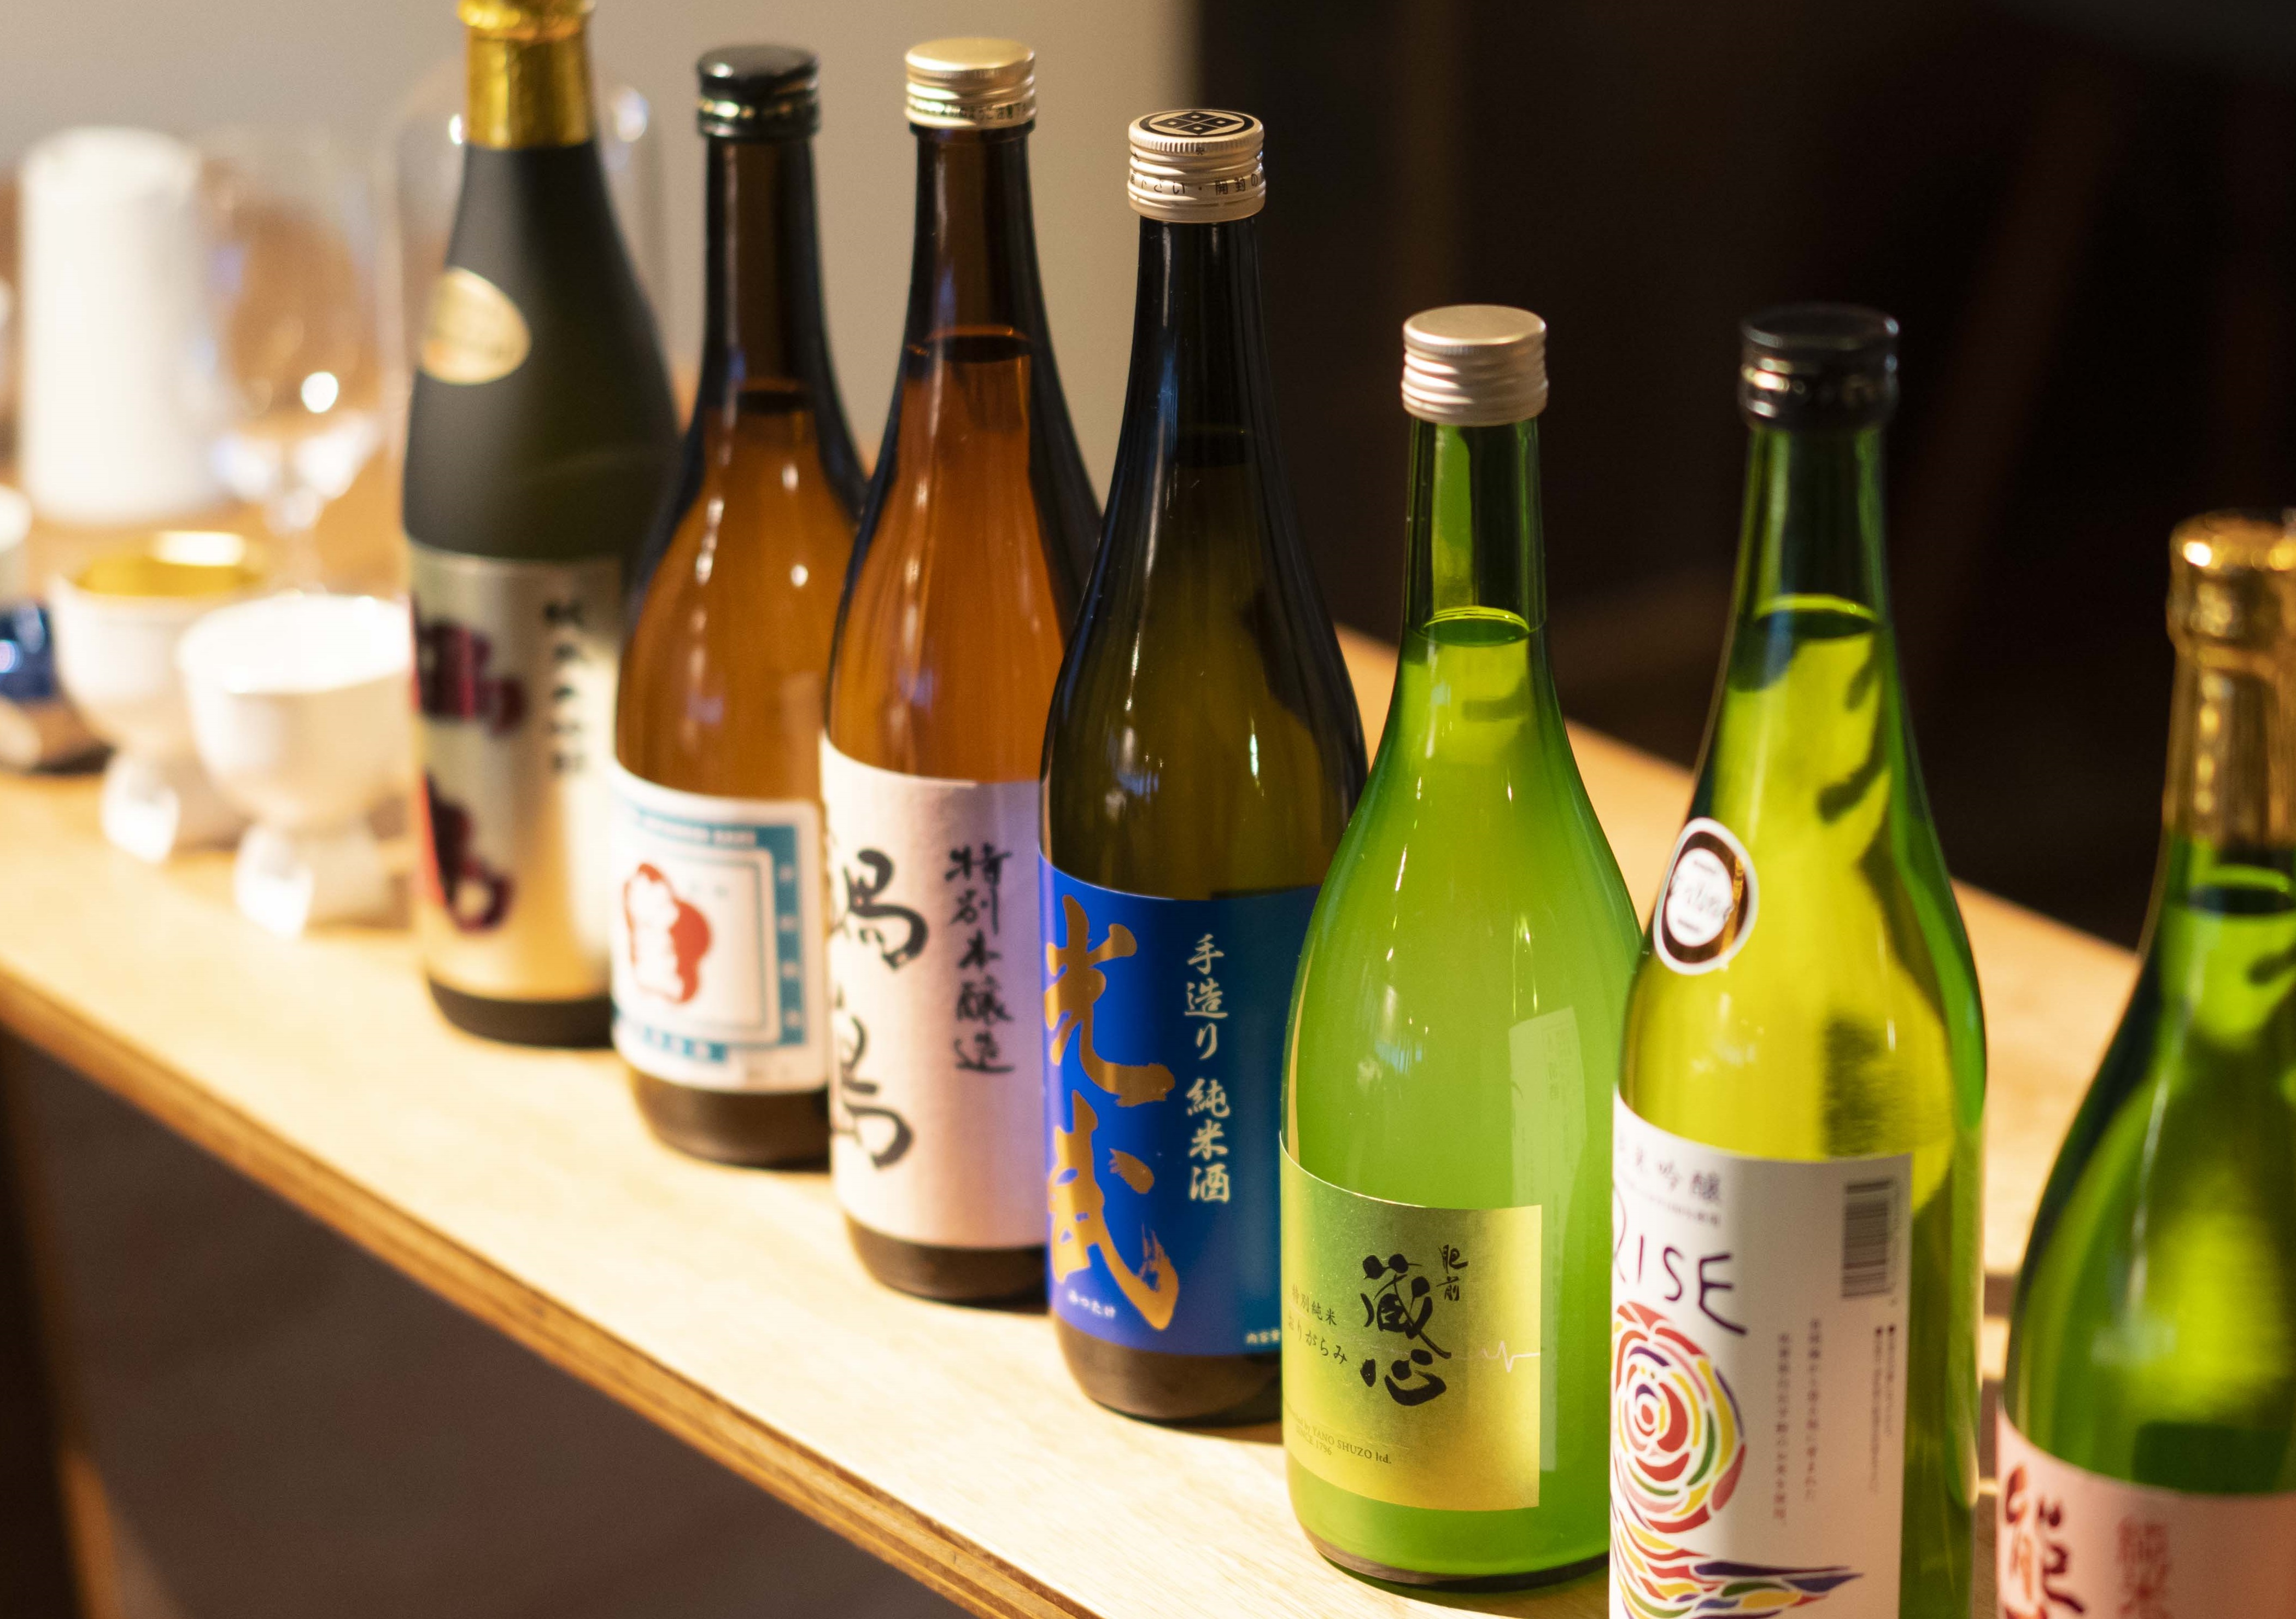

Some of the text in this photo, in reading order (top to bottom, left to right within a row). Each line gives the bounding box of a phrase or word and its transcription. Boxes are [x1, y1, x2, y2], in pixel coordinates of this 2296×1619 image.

[1045, 895, 1179, 1331] 光武
[1184, 934, 1230, 1203] 手造り 純米酒
[1292, 1284, 1338, 1326] 特別純米
[1311, 1425, 1335, 1445] YANO
[1337, 1439, 1373, 1459] SHUZO
